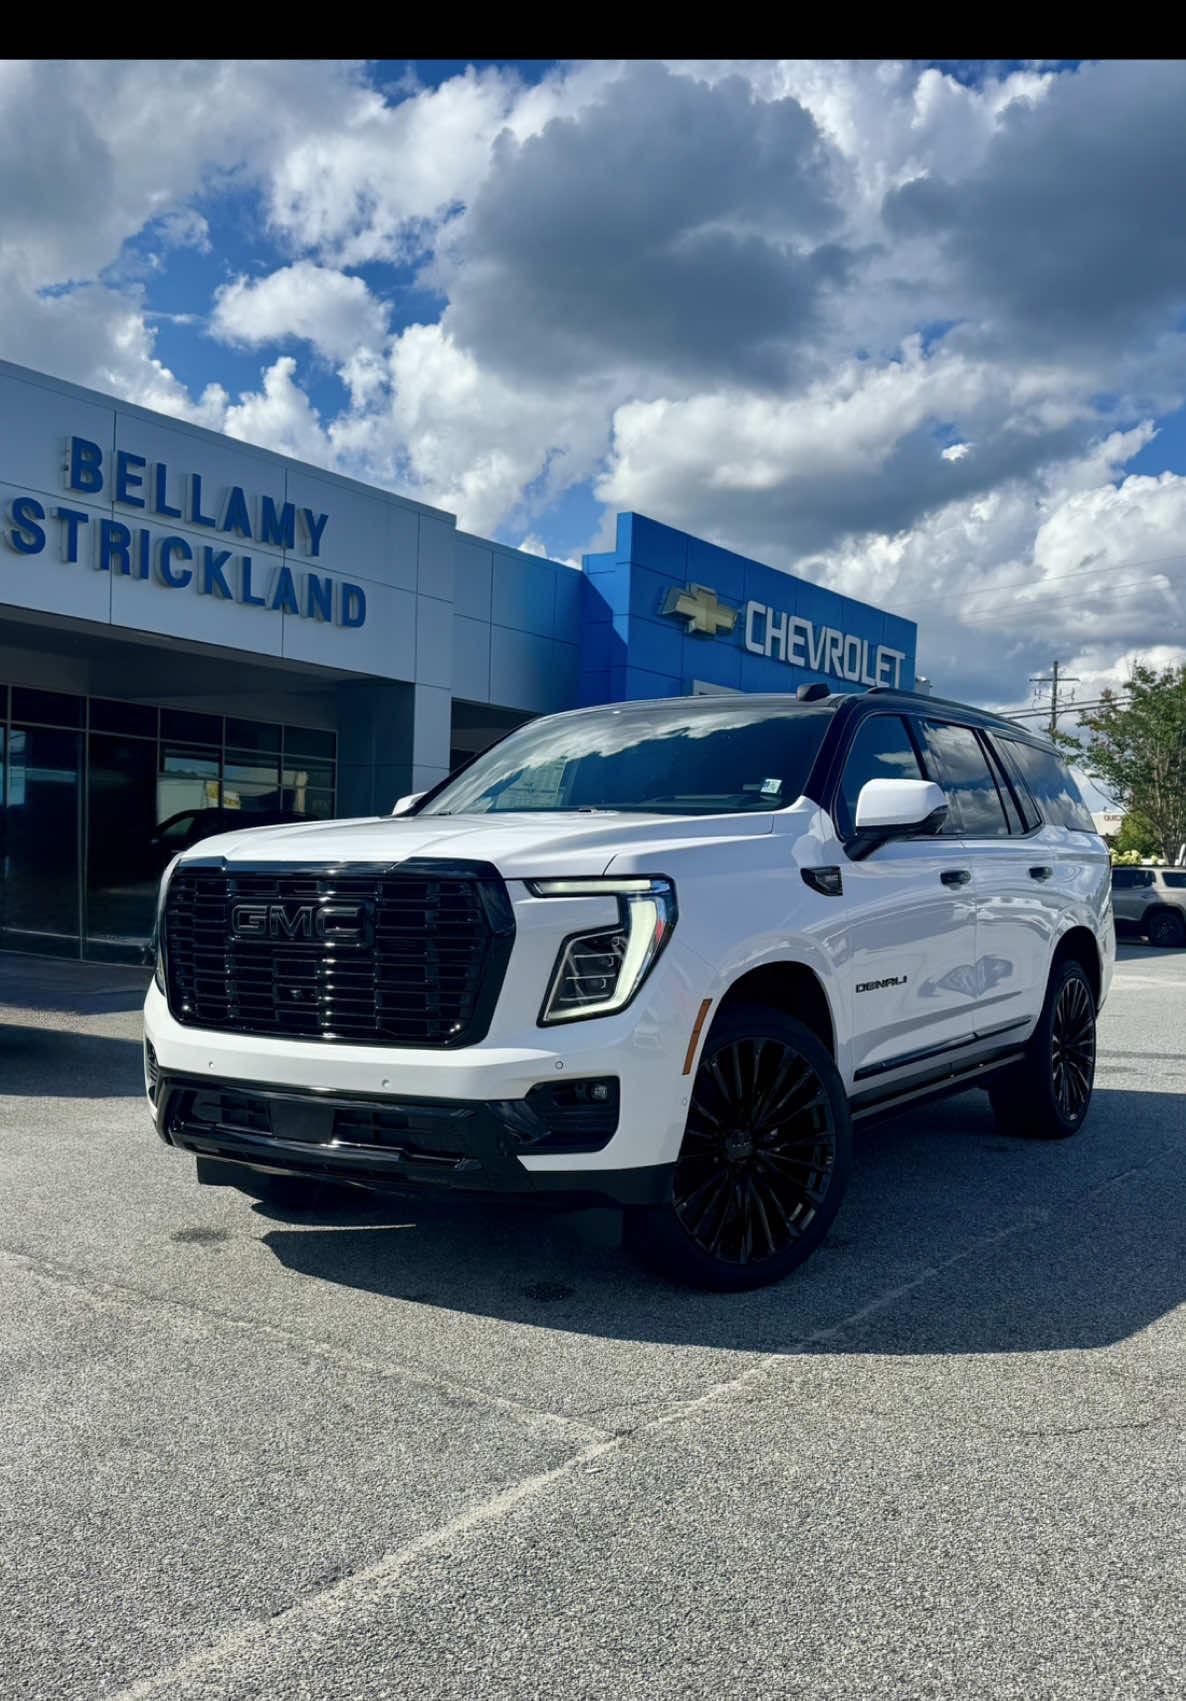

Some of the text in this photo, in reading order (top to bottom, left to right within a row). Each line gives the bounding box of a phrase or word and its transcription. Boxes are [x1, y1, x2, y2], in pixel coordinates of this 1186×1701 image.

[65, 436, 329, 557] BELLAMY
[7, 497, 366, 628] STRICKLAND
[745, 600, 905, 687] CHEVROLET
[232, 904, 362, 937] GMC
[856, 976, 907, 993] DENALI
